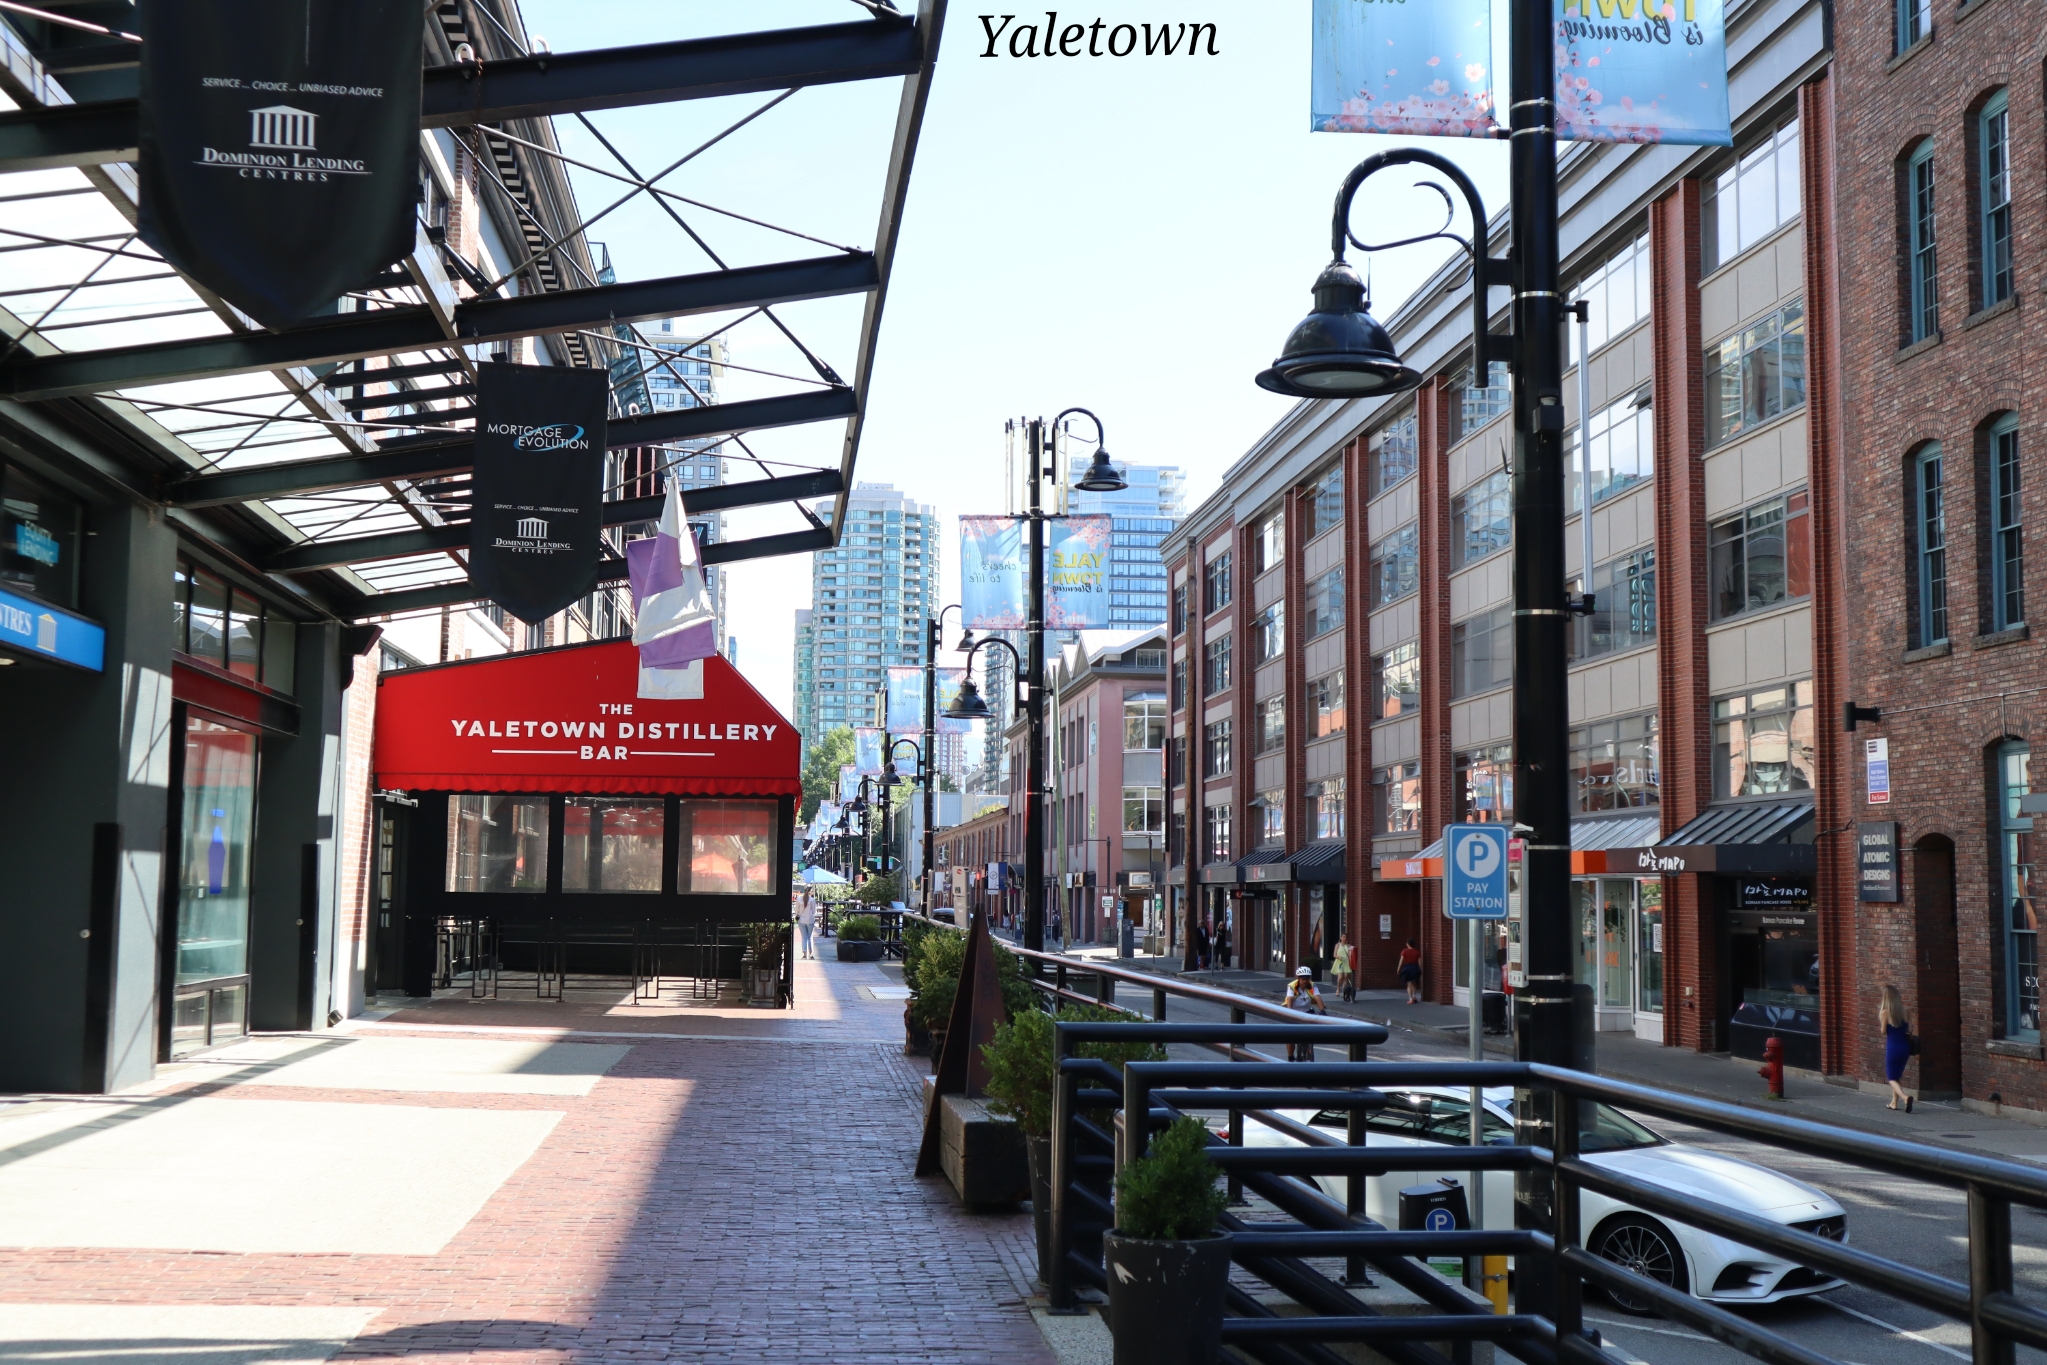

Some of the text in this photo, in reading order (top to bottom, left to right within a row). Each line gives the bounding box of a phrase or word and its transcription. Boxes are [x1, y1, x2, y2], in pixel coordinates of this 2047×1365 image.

[252, 80, 288, 92] CHOICE
[299, 83, 347, 95] UNBIASED
[348, 86, 384, 98] ADVICE
[202, 147, 365, 171] DOMINION LENDING
[239, 168, 328, 182] CENTRES
[487, 423, 562, 438] MORTGAGE
[518, 436, 589, 450] EVOLUTION
[495, 537, 571, 549] DOMINION LENDING
[511, 547, 554, 555] CENTRES
[599, 703, 633, 715] THE
[451, 720, 777, 741] YALETOWN DISTILLERY
[580, 745, 628, 760] BAR
[1863, 834, 1890, 846] GLOBAL
[1468, 840, 1490, 872] P
[1863, 851, 1891, 864] ATOMIC
[1658, 856, 1685, 871] MAPO
[1864, 869, 1891, 881] DESIGNS
[1467, 882, 1489, 894] PAY
[1773, 887, 1808, 897] MAPO
[1454, 897, 1503, 909] STATION
[1793, 917, 1805, 925] House
[1434, 1214, 1448, 1231] P
